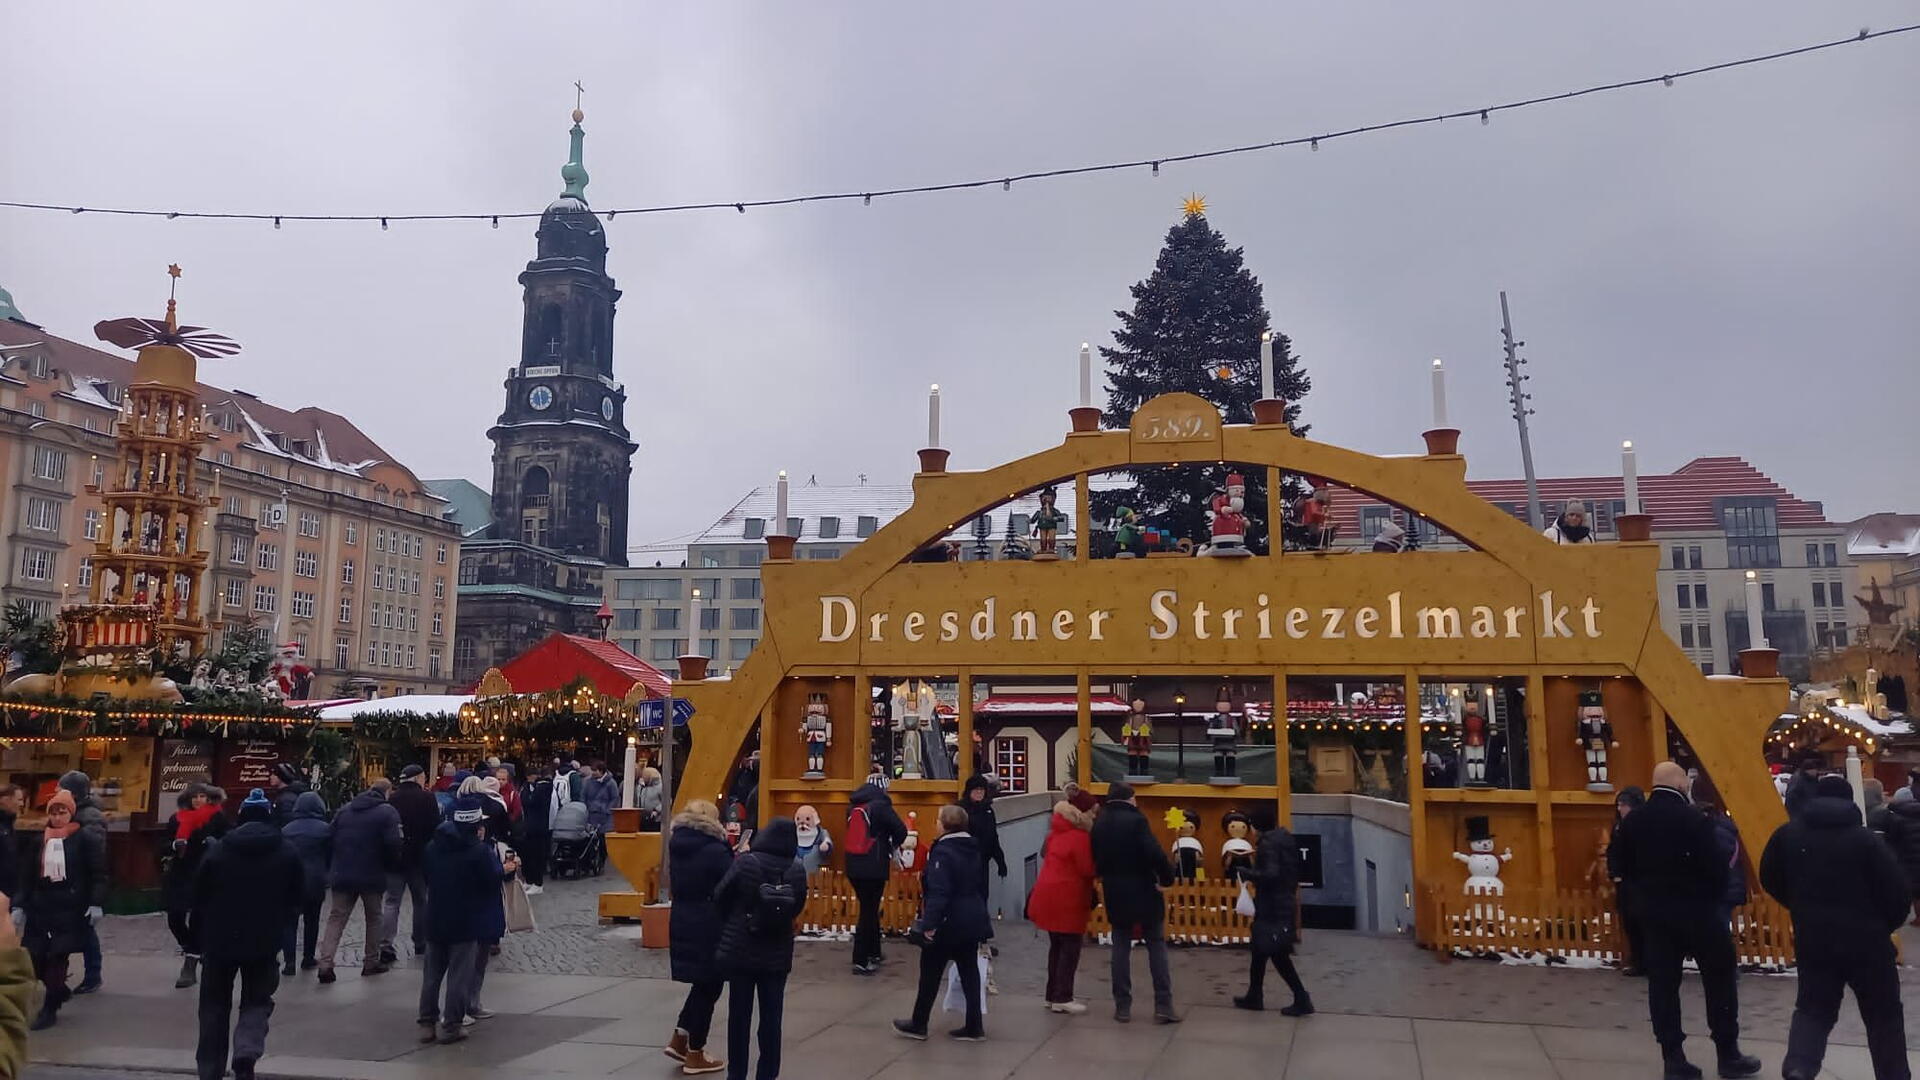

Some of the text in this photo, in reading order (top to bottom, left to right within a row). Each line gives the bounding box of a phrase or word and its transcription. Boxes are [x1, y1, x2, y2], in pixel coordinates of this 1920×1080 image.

[273, 509, 281, 520] D
[818, 589, 1602, 642] Dresdner Striezelmarkt
[652, 709, 663, 719] WC
[161, 762, 208, 776] gebrannte
[162, 778, 188, 790] Man
